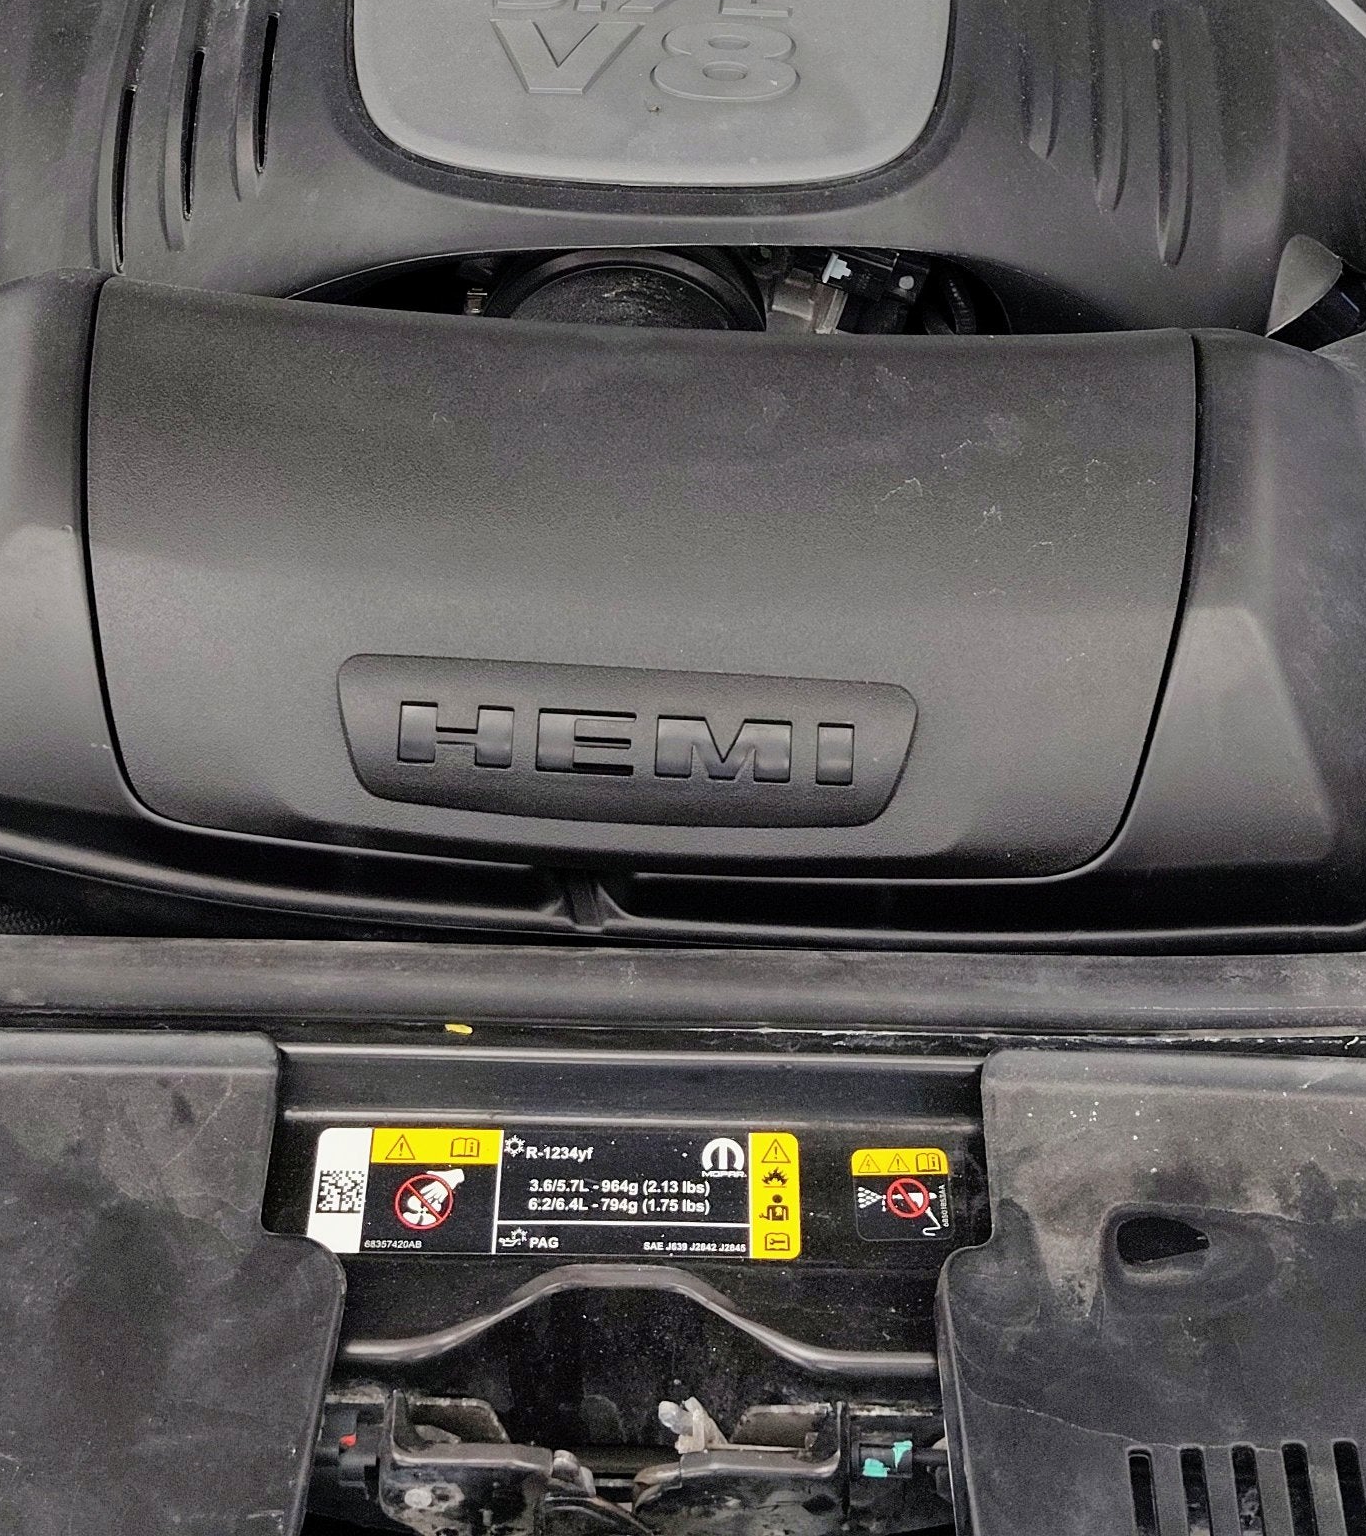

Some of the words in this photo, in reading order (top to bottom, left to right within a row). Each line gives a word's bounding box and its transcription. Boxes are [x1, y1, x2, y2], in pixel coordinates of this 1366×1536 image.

[489, 18, 801, 102] V8
[396, 700, 856, 786] HEMI
[525, 1146, 594, 1162] R-1234yf
[528, 1178, 589, 1193] 3.6/5.7L
[601, 1179, 639, 1196] 964g
[642, 1179, 679, 1195] (2.13
[682, 1180, 711, 1197] lbs)
[528, 1197, 589, 1211] 6.2/6.4L
[601, 1197, 638, 1214] 794g
[642, 1197, 678, 1214] (1.75
[682, 1198, 711, 1215] lbs)
[529, 1236, 559, 1249] PAG
[643, 1241, 664, 1251] SAE
